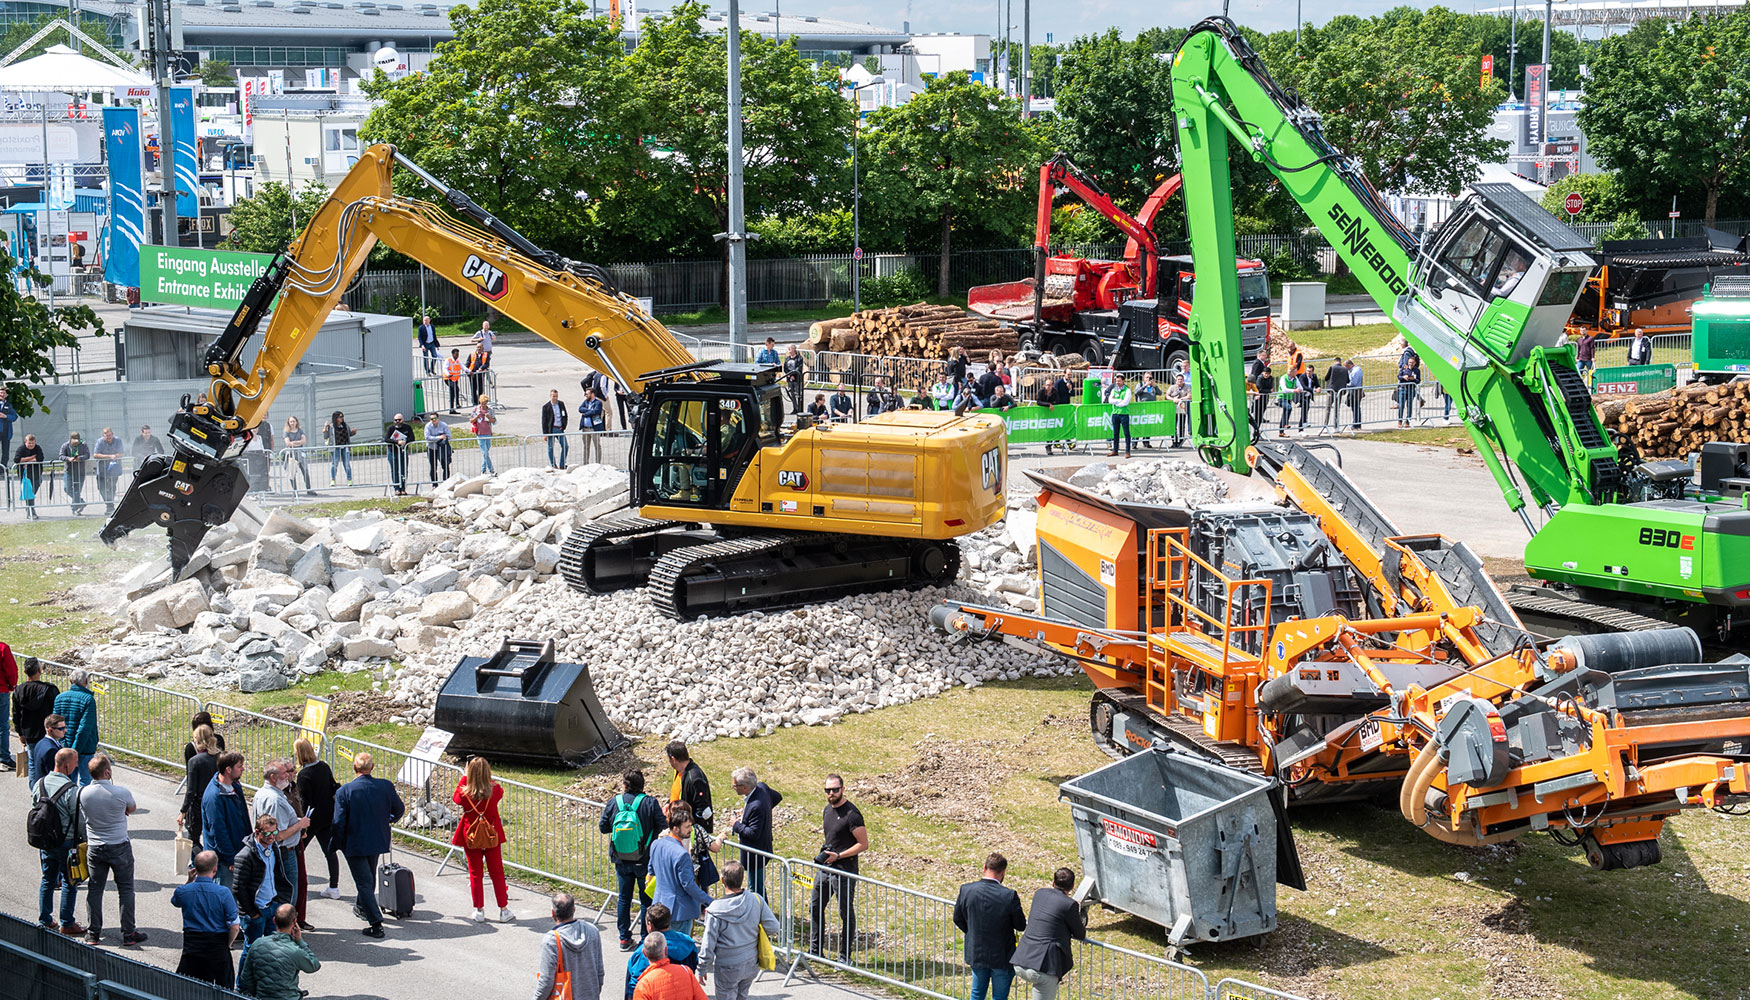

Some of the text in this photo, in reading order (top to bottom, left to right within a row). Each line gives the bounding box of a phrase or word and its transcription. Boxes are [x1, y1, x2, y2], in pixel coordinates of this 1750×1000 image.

[127, 87, 150, 97] Hako
[207, 128, 225, 136] IVECO
[1566, 199, 1582, 208] STOP
[1328, 203, 1411, 297] SENNEBOG
[158, 253, 268, 278] Eingang Ausstelle
[462, 254, 503, 292] CAT
[158, 277, 250, 300] Entrance Exhib
[1599, 384, 1635, 394] JENZ
[719, 399, 736, 409] 340
[982, 447, 999, 489] CAT
[174, 480, 191, 492] CAT
[779, 471, 802, 487] CAT
[1638, 527, 1696, 551] 830E
[1101, 560, 1114, 577] BMD
[1360, 719, 1380, 740] BMD
[1103, 819, 1152, 847] REMONDIS
